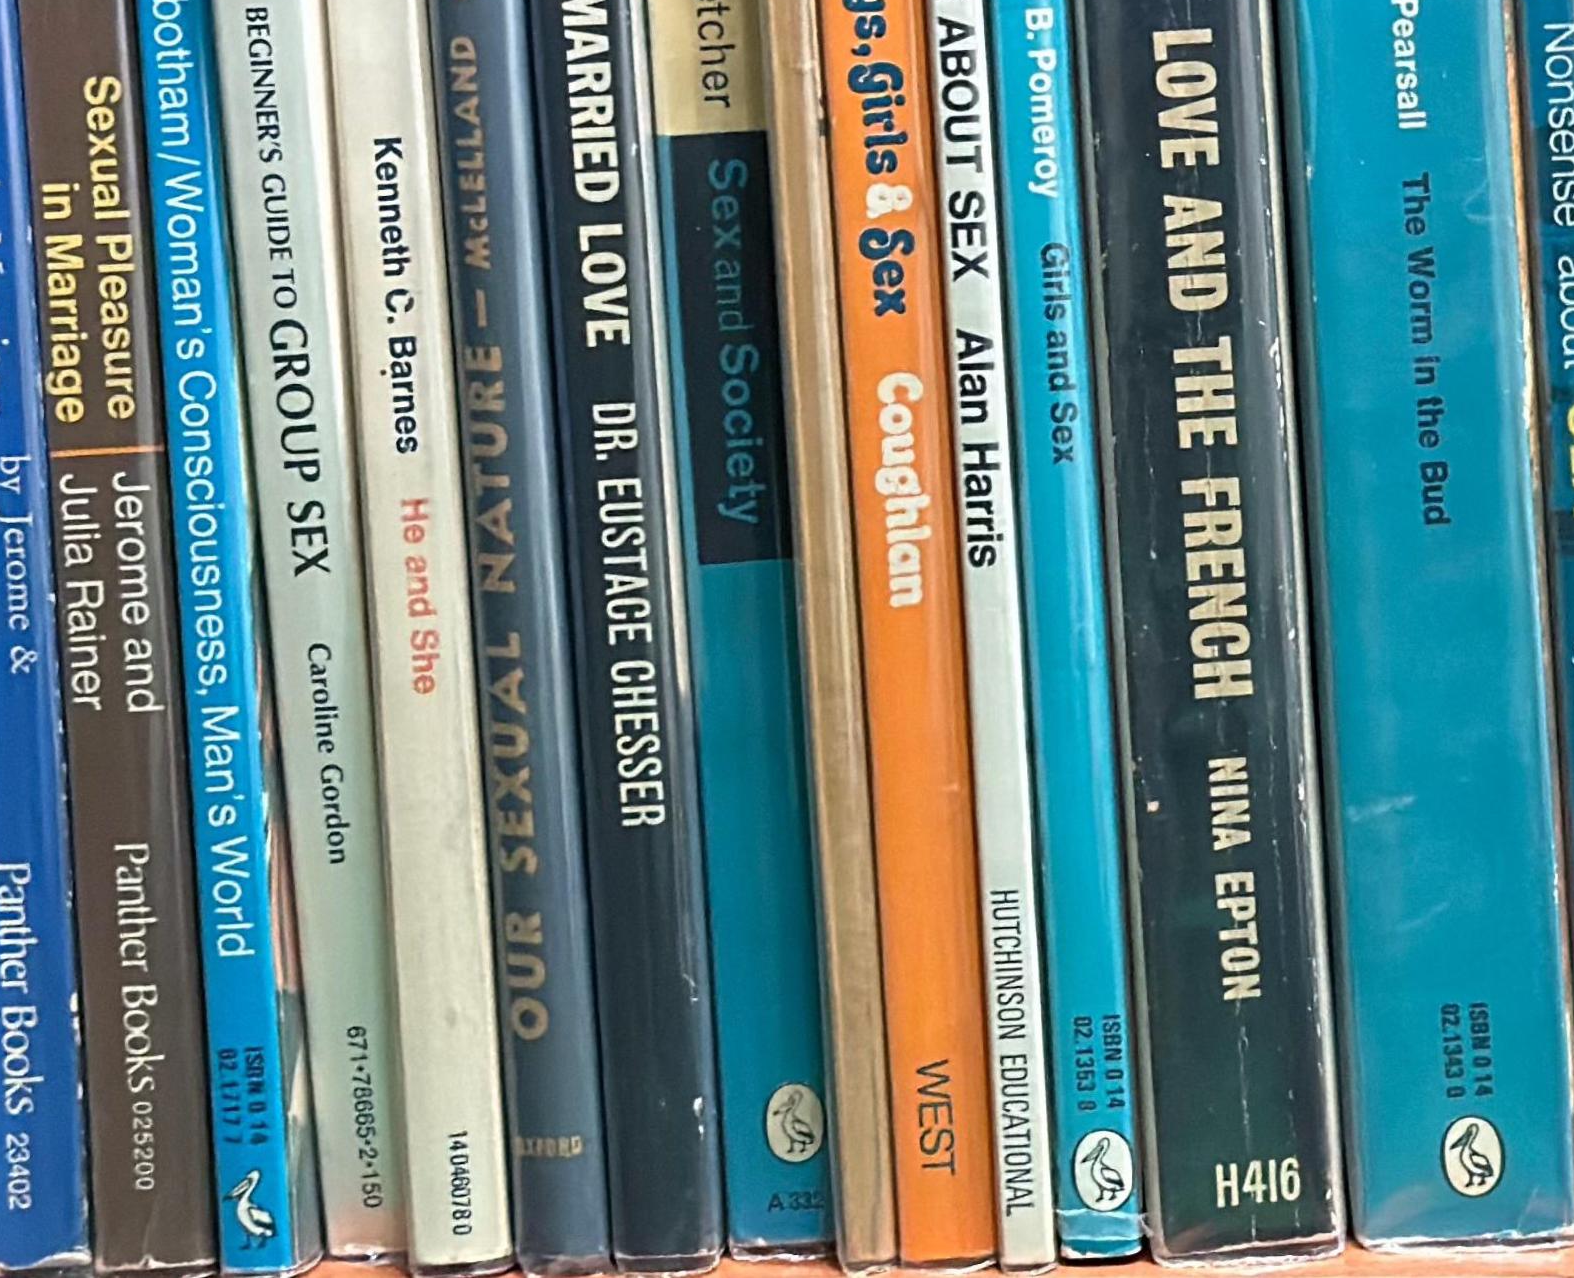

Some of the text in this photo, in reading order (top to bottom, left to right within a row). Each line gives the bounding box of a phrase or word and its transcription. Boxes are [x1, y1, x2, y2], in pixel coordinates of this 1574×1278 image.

[935, 18, 984, 172] ABOUT
[83, 73, 136, 421] Sexual Pleasure
[374, 135, 418, 455] Kenneth C. Barnes
[577, 222, 630, 347] LOVE
[948, 190, 987, 283] SEX
[402, 498, 436, 696] He and She
[1153, 28, 1261, 1002] LOVE AND THE FRENCH NINA EPTON
[306, 642, 346, 865] Caroline Gordon
[916, 1058, 955, 1177] WEST
[991, 888, 1036, 1217] HUTCHINSON EDUCATIONAL
